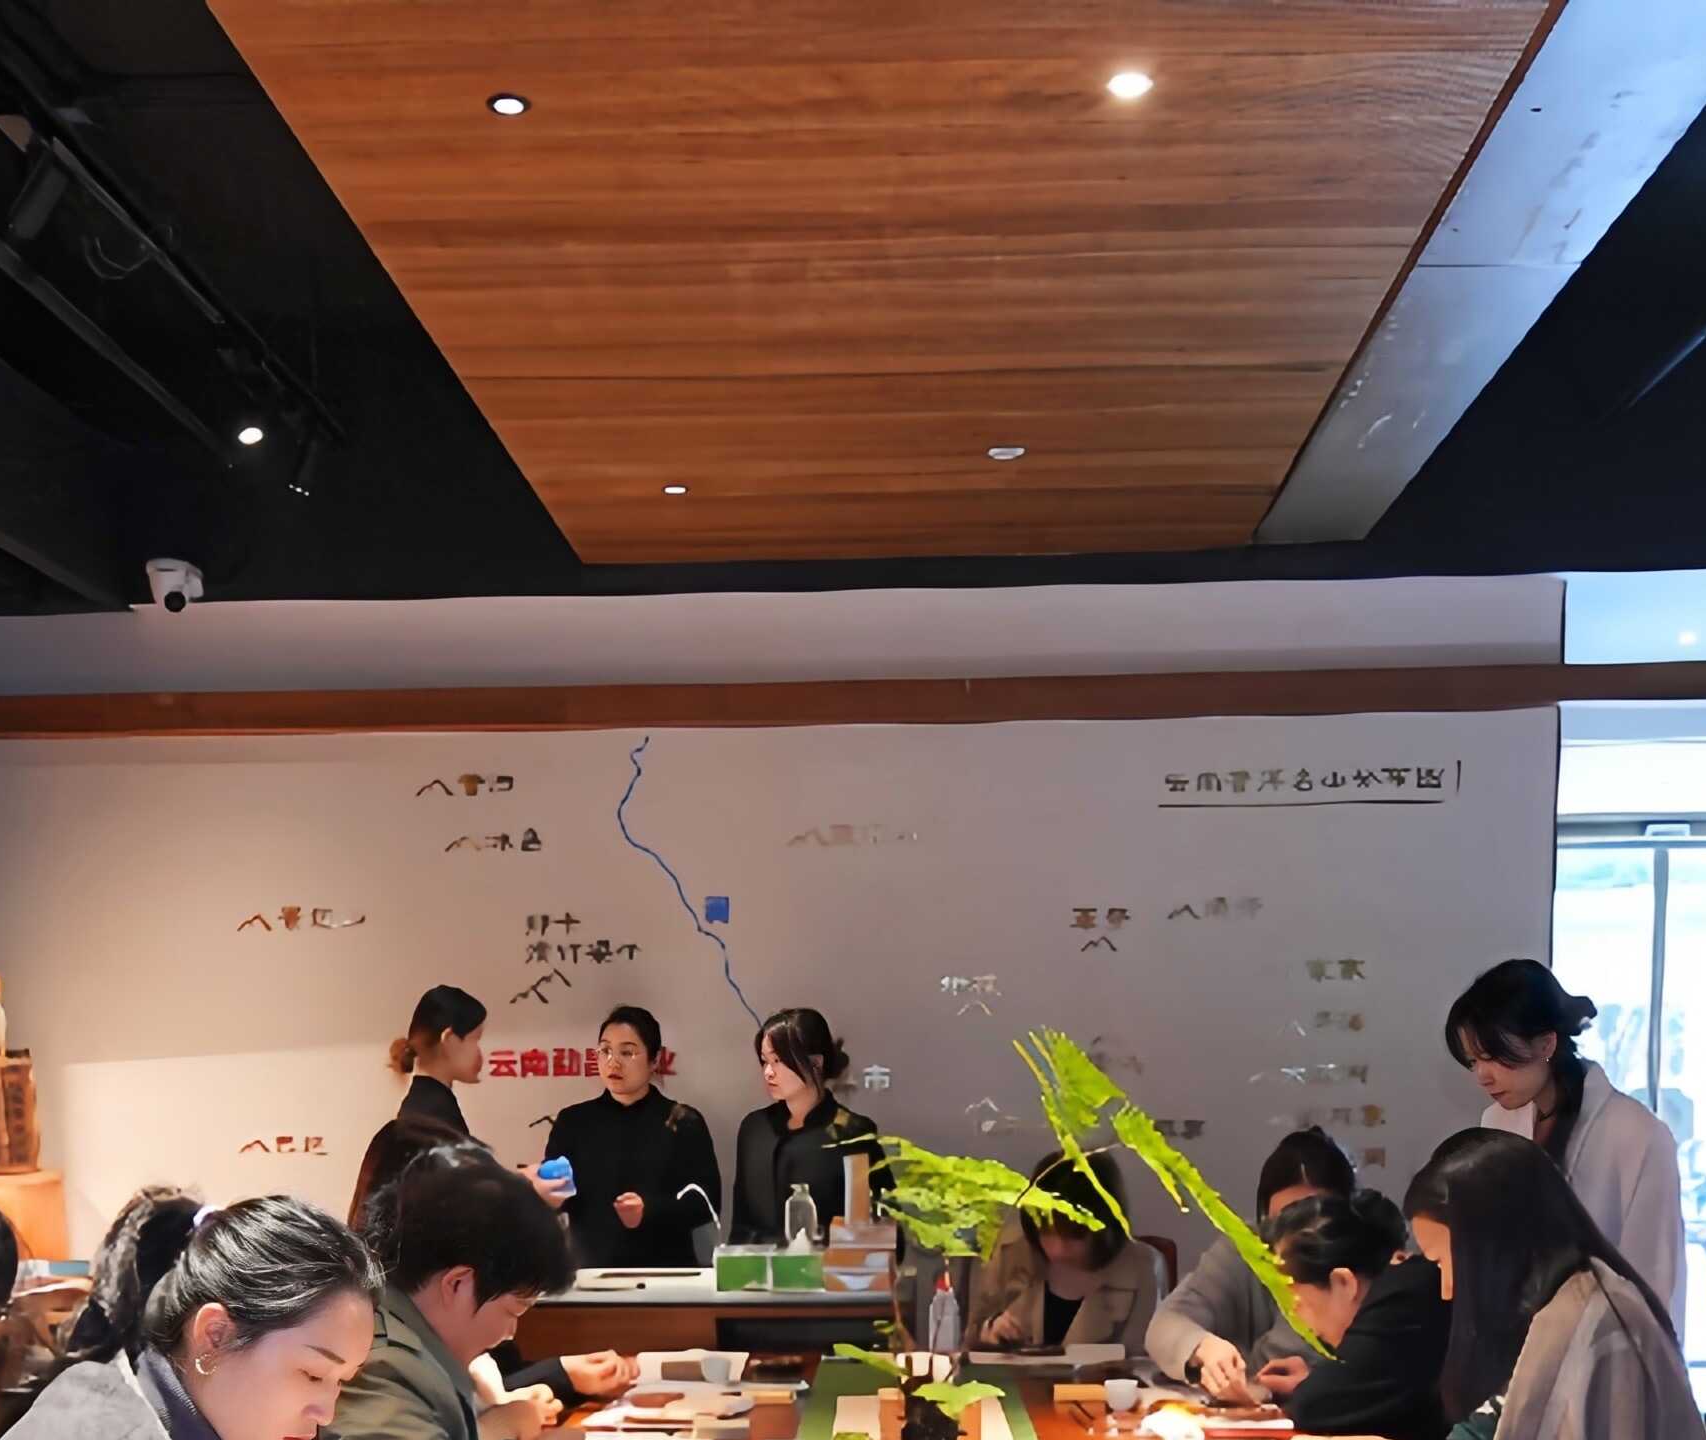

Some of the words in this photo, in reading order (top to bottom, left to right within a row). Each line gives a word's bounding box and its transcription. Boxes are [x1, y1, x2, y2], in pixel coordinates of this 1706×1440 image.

[488, 1046, 678, 1078] 云南勐昌业
